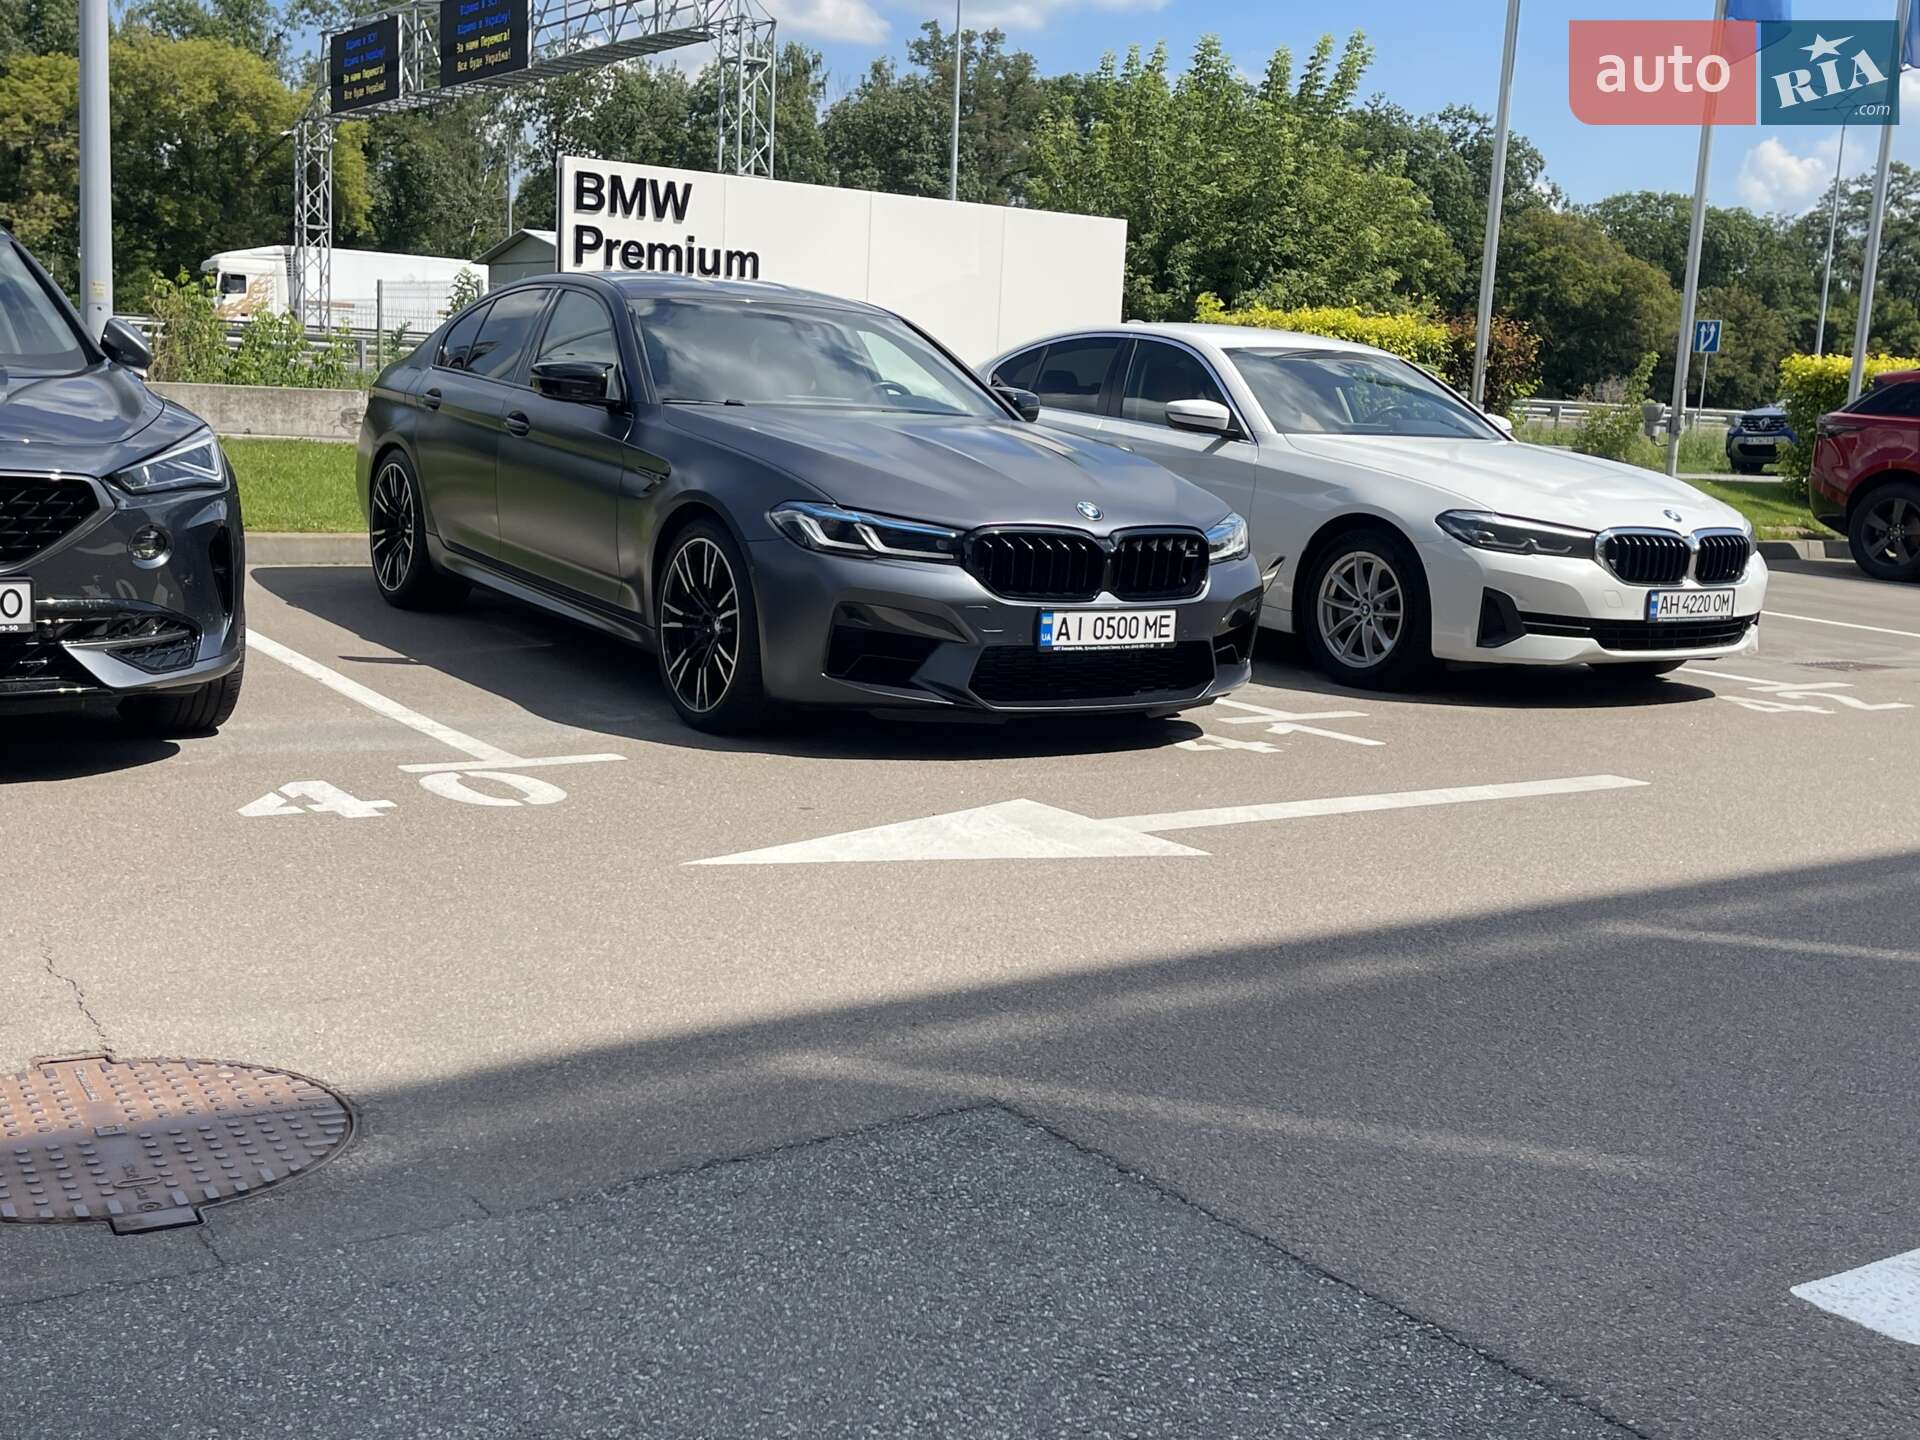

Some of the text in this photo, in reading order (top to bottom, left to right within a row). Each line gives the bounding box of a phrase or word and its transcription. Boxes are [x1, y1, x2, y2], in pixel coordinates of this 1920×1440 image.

[574, 171, 693, 223] BMW
[573, 225, 760, 280] Premium
[1659, 595, 1680, 614] AH
[1682, 594, 1711, 613] 4220
[1713, 593, 1730, 612] OM
[1056, 615, 1171, 640] AI 0500 ME
[236, 771, 568, 818] 40
